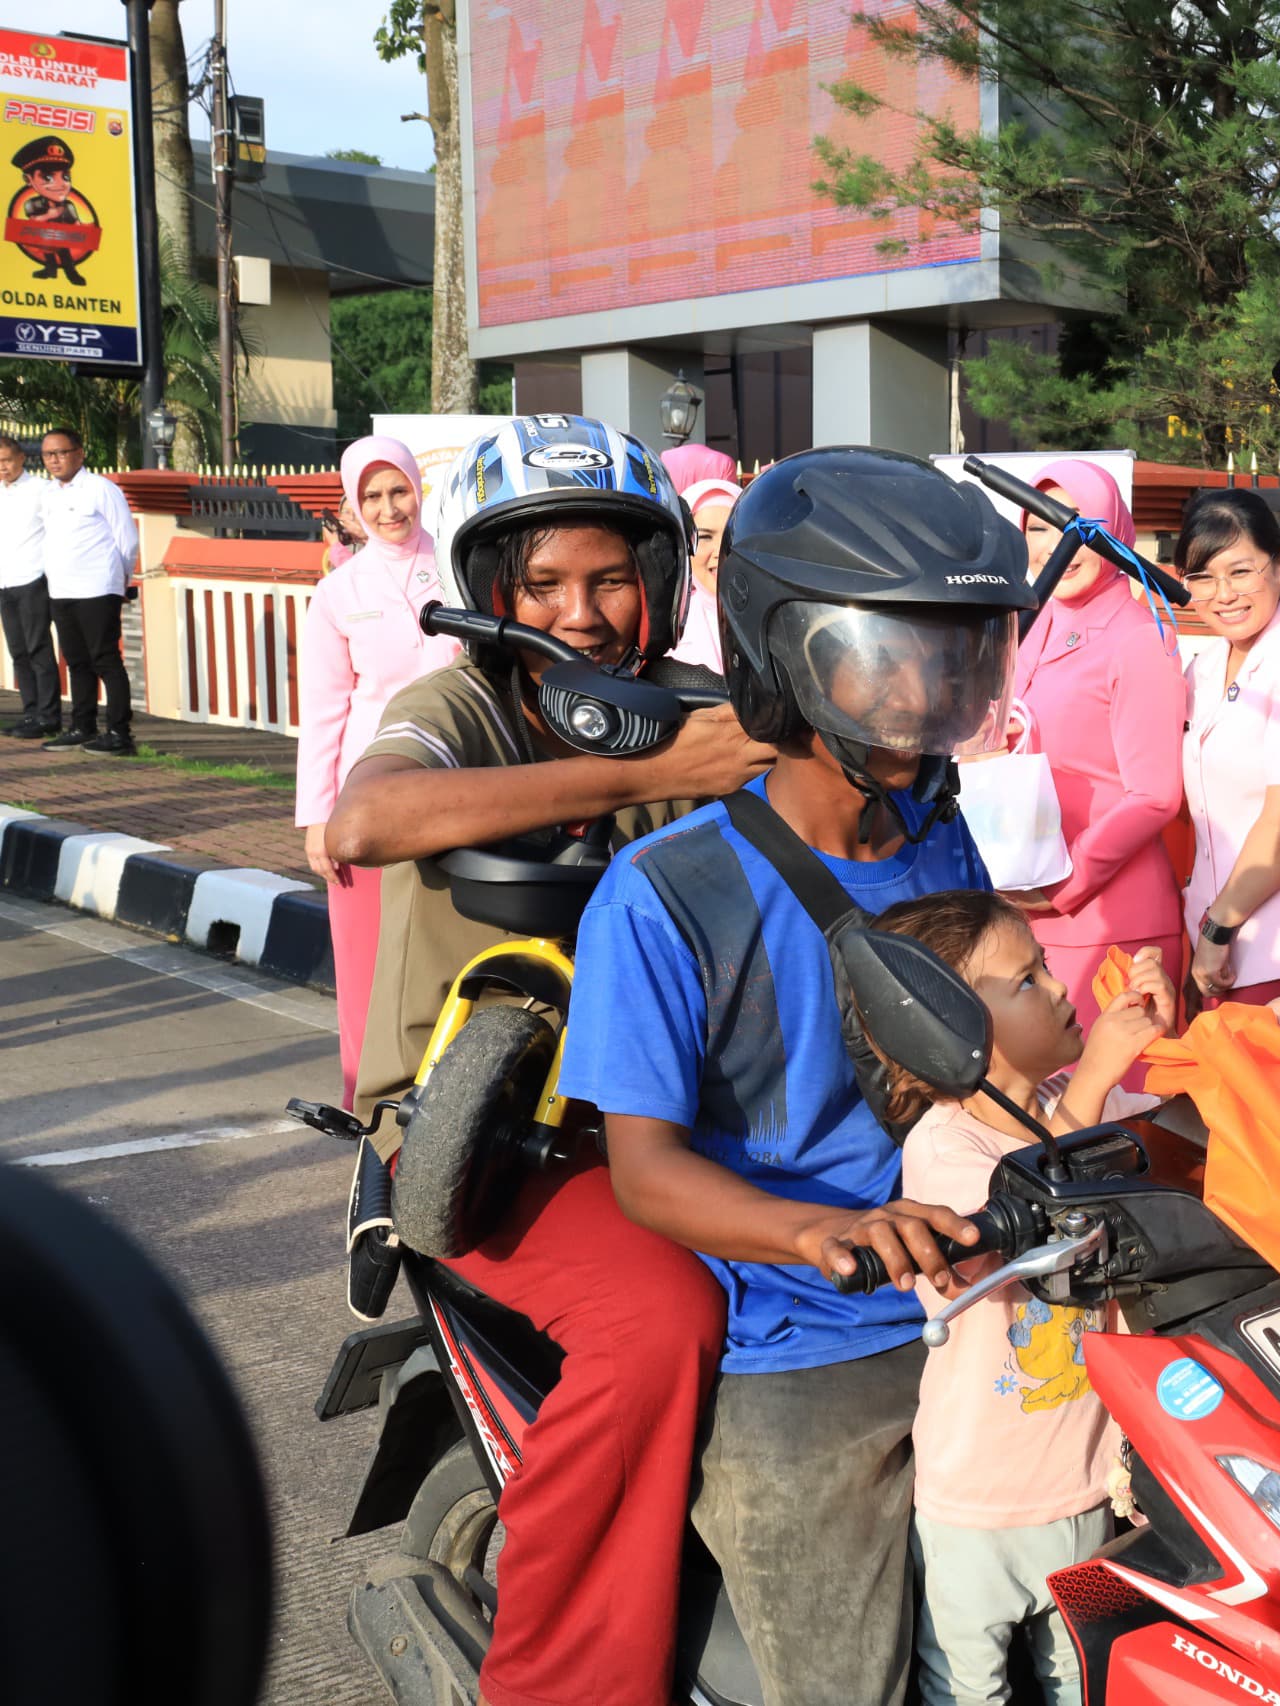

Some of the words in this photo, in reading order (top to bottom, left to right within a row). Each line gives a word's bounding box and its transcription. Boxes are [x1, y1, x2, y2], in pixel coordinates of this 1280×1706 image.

[41, 59, 98, 76] UNTUK
[4, 99, 96, 133] PRESISI
[53, 294, 121, 314] BANTEN
[36, 324, 102, 345] YSP
[944, 573, 1010, 585] HONDA
